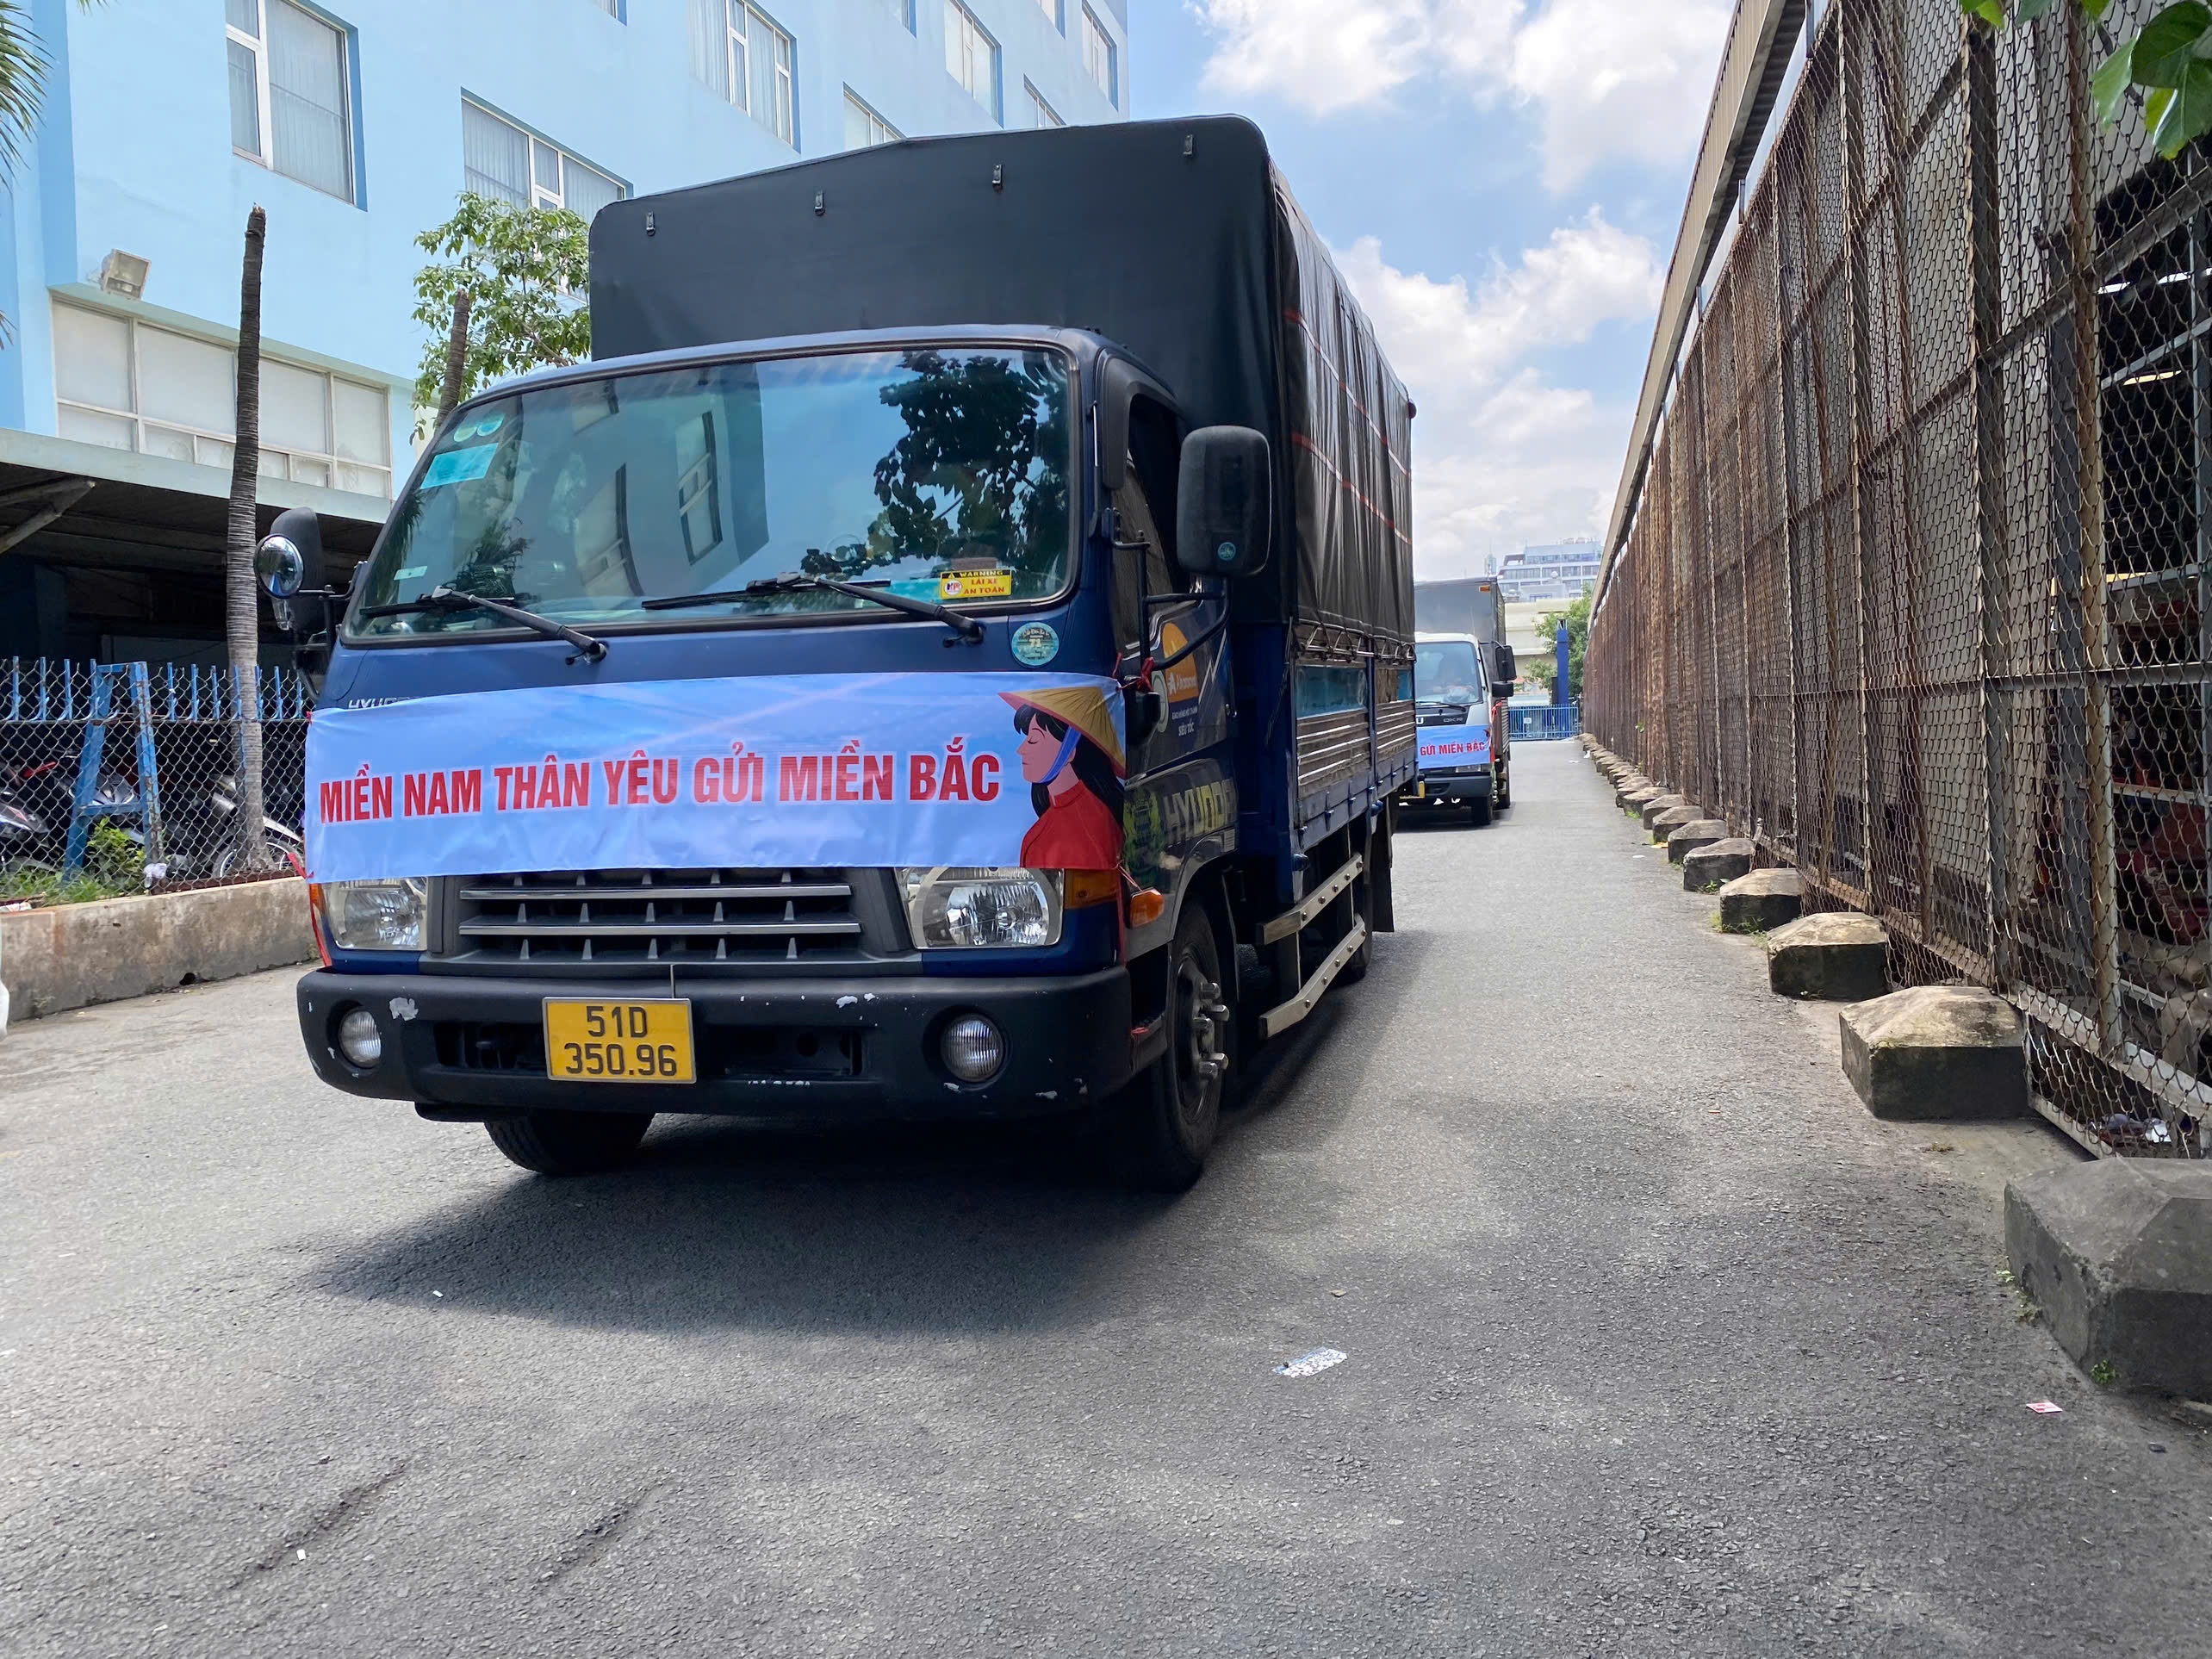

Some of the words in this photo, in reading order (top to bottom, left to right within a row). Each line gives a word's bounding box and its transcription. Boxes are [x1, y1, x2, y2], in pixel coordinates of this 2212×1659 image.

[320, 760, 393, 823] MIỀN
[404, 769, 482, 817] NAM
[494, 755, 590, 811] THÂN
[604, 749, 678, 805] YÊU
[694, 742, 763, 803] GỬI
[780, 738, 894, 801] MIỀN
[910, 736, 1000, 802] BẮC
[586, 1005, 648, 1038] 51D
[564, 1042, 677, 1077] 350.96
